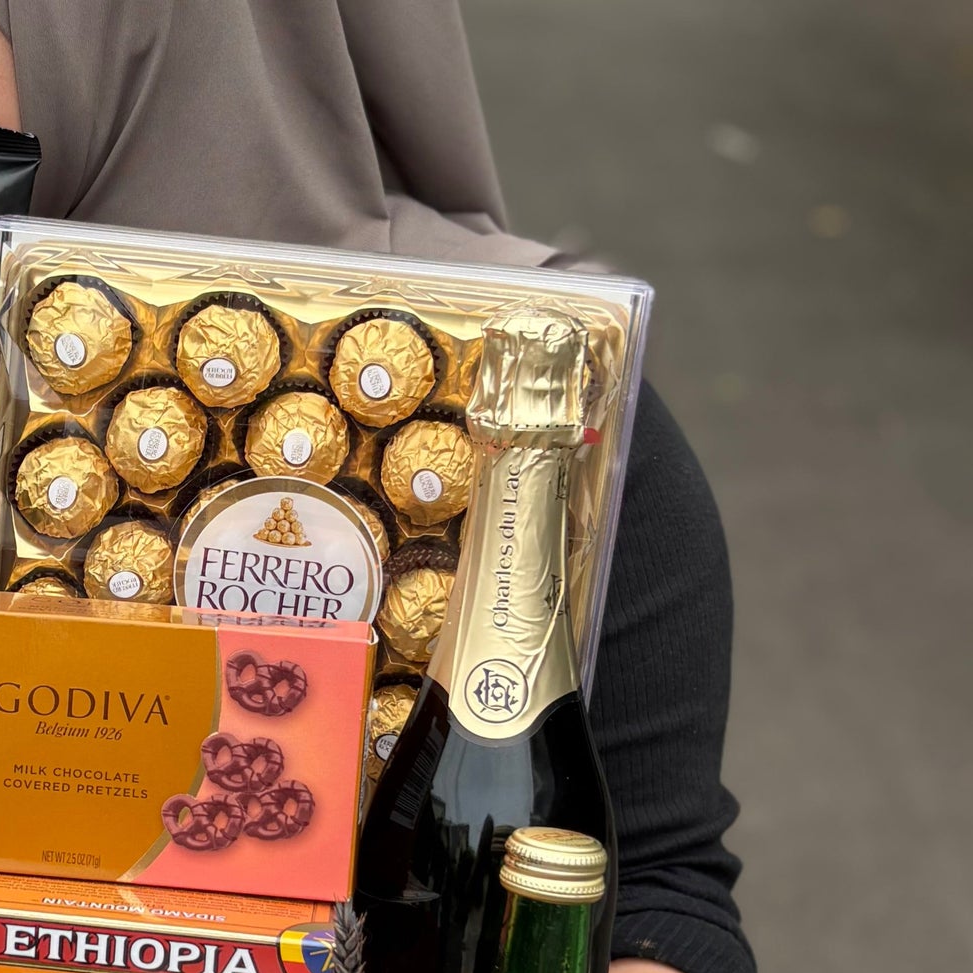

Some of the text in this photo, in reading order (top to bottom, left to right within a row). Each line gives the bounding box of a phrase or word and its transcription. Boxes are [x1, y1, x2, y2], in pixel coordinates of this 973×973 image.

[492, 464, 520, 628] Charles du Lac
[200, 546, 354, 596] FERRERO
[196, 580, 343, 620] ROCHER
[35, 721, 123, 741] Belgium 1926
[14, 764, 140, 783] MILK CHOCOLATE
[3, 778, 148, 799] COVERED PRETZELS
[42, 850, 54, 863] NET
[55, 851, 66, 864] WT
[41, 896, 227, 922] SIDAMO MOUNTAIN
